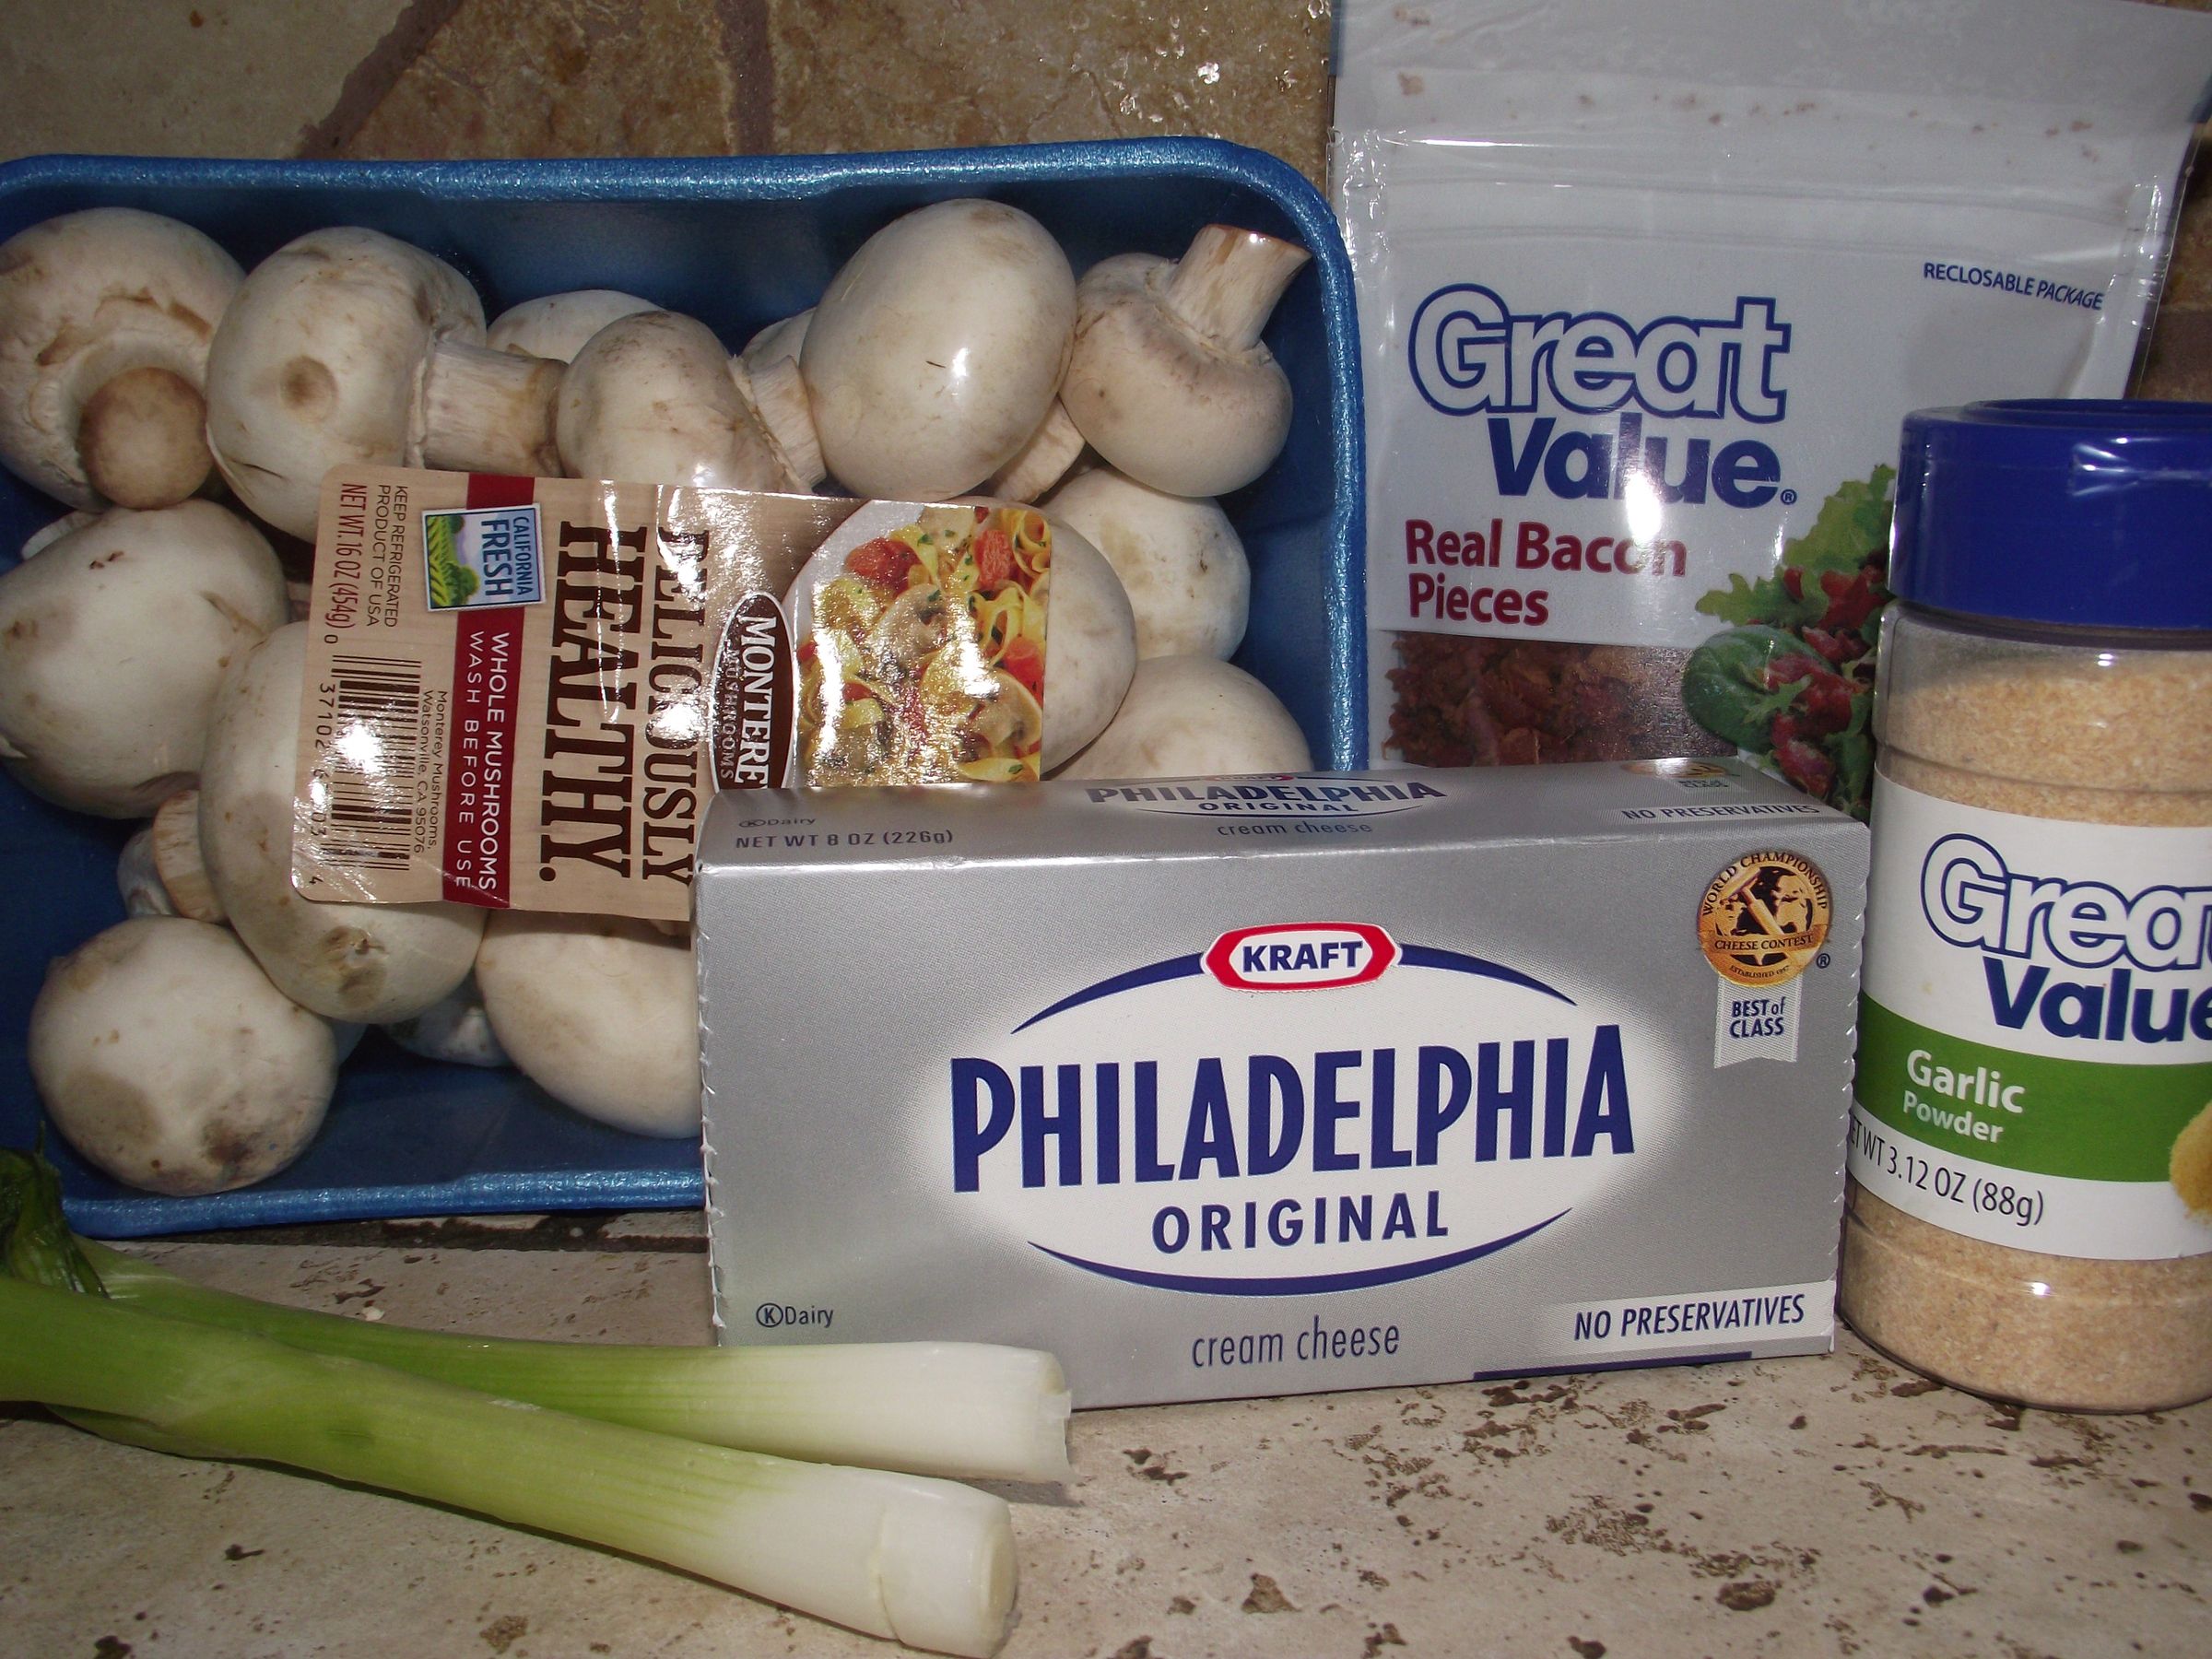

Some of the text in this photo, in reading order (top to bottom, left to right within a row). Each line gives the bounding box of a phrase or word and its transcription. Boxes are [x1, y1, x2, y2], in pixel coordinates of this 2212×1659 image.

[1924, 262, 2104, 311] RECLOSABLE PACKAGE
[1407, 283, 1793, 423] Great
[1487, 412, 1782, 509] Value
[324, 484, 367, 629] NET WT. 16 OZ (454g)
[366, 485, 391, 627] PRODUCT OF USA
[384, 485, 408, 628] KEEP REFRIGERATED
[481, 519, 514, 596] FRESH
[512, 516, 534, 597] CALIFORNIA
[1405, 518, 1687, 578] Real Bacon
[1408, 574, 1549, 628] Pieces
[539, 521, 647, 883] HEALTHY.
[642, 526, 710, 887] DELICOUSLY
[720, 650, 740, 779] MUSHROOMS
[735, 616, 777, 789] MONTERE
[413, 690, 434, 853] Watsonville, CA 95076
[427, 691, 448, 850] Monterey Mushrooms,
[455, 630, 484, 888] WASH BEFORE USE
[477, 632, 511, 890] WHOLE MUSHROOMS
[1086, 782, 1447, 803] PHILADELPHIA
[735, 830, 953, 848] NET WT 8 OZ (226g)
[1198, 802, 1359, 812] ORIGINAL
[1218, 819, 1372, 837] cream cheese
[1621, 805, 1820, 819] NO PRESERVATIVES
[1702, 852, 1828, 916] WORLD CHAMPIONSHIP
[1921, 833, 2212, 972] Grea
[1241, 939, 1364, 972] KRAFT
[1714, 935, 1813, 950] CHEESE CONTEST
[1729, 1017, 1785, 1039] CLASS
[1731, 996, 1786, 1018] BEST of
[950, 1024, 1635, 1194] PHILADELPHIA
[1903, 1089, 2004, 1143] Powder
[1907, 1049, 2026, 1113] Garlic
[1862, 1124, 1886, 1166] WT
[1887, 1146, 1929, 1191] 3.12
[1934, 1167, 1967, 1204] OZ
[1972, 1178, 2043, 1226] (88g)
[1152, 1190, 1449, 1254] ORIGINAL
[1193, 1315, 1400, 1369] cream cheese
[1573, 1293, 1806, 1341] NO PRESERVATIVES
